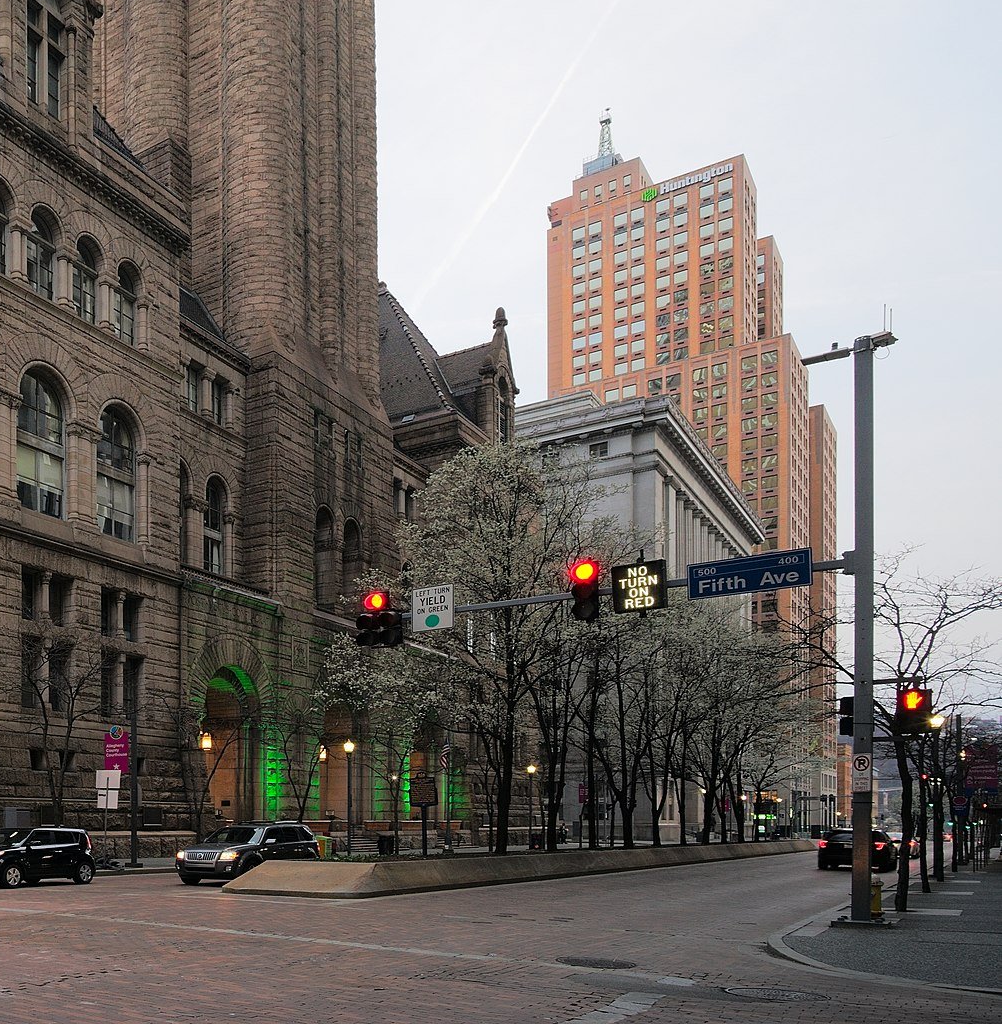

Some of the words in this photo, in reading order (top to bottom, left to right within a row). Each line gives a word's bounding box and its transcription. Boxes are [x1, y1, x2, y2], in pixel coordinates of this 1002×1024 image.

[659, 163, 733, 195] Huntington
[698, 567, 716, 576] 500
[778, 555, 798, 565] 400
[627, 566, 648, 578] NO
[619, 575, 658, 589] TURN
[698, 575, 746, 594] Fifth
[759, 571, 799, 586] Ave
[434, 587, 450, 595] TURN
[629, 587, 649, 598] ON
[420, 595, 446, 606] YIELD
[624, 596, 655, 609] RED
[428, 605, 449, 613] GREEN
